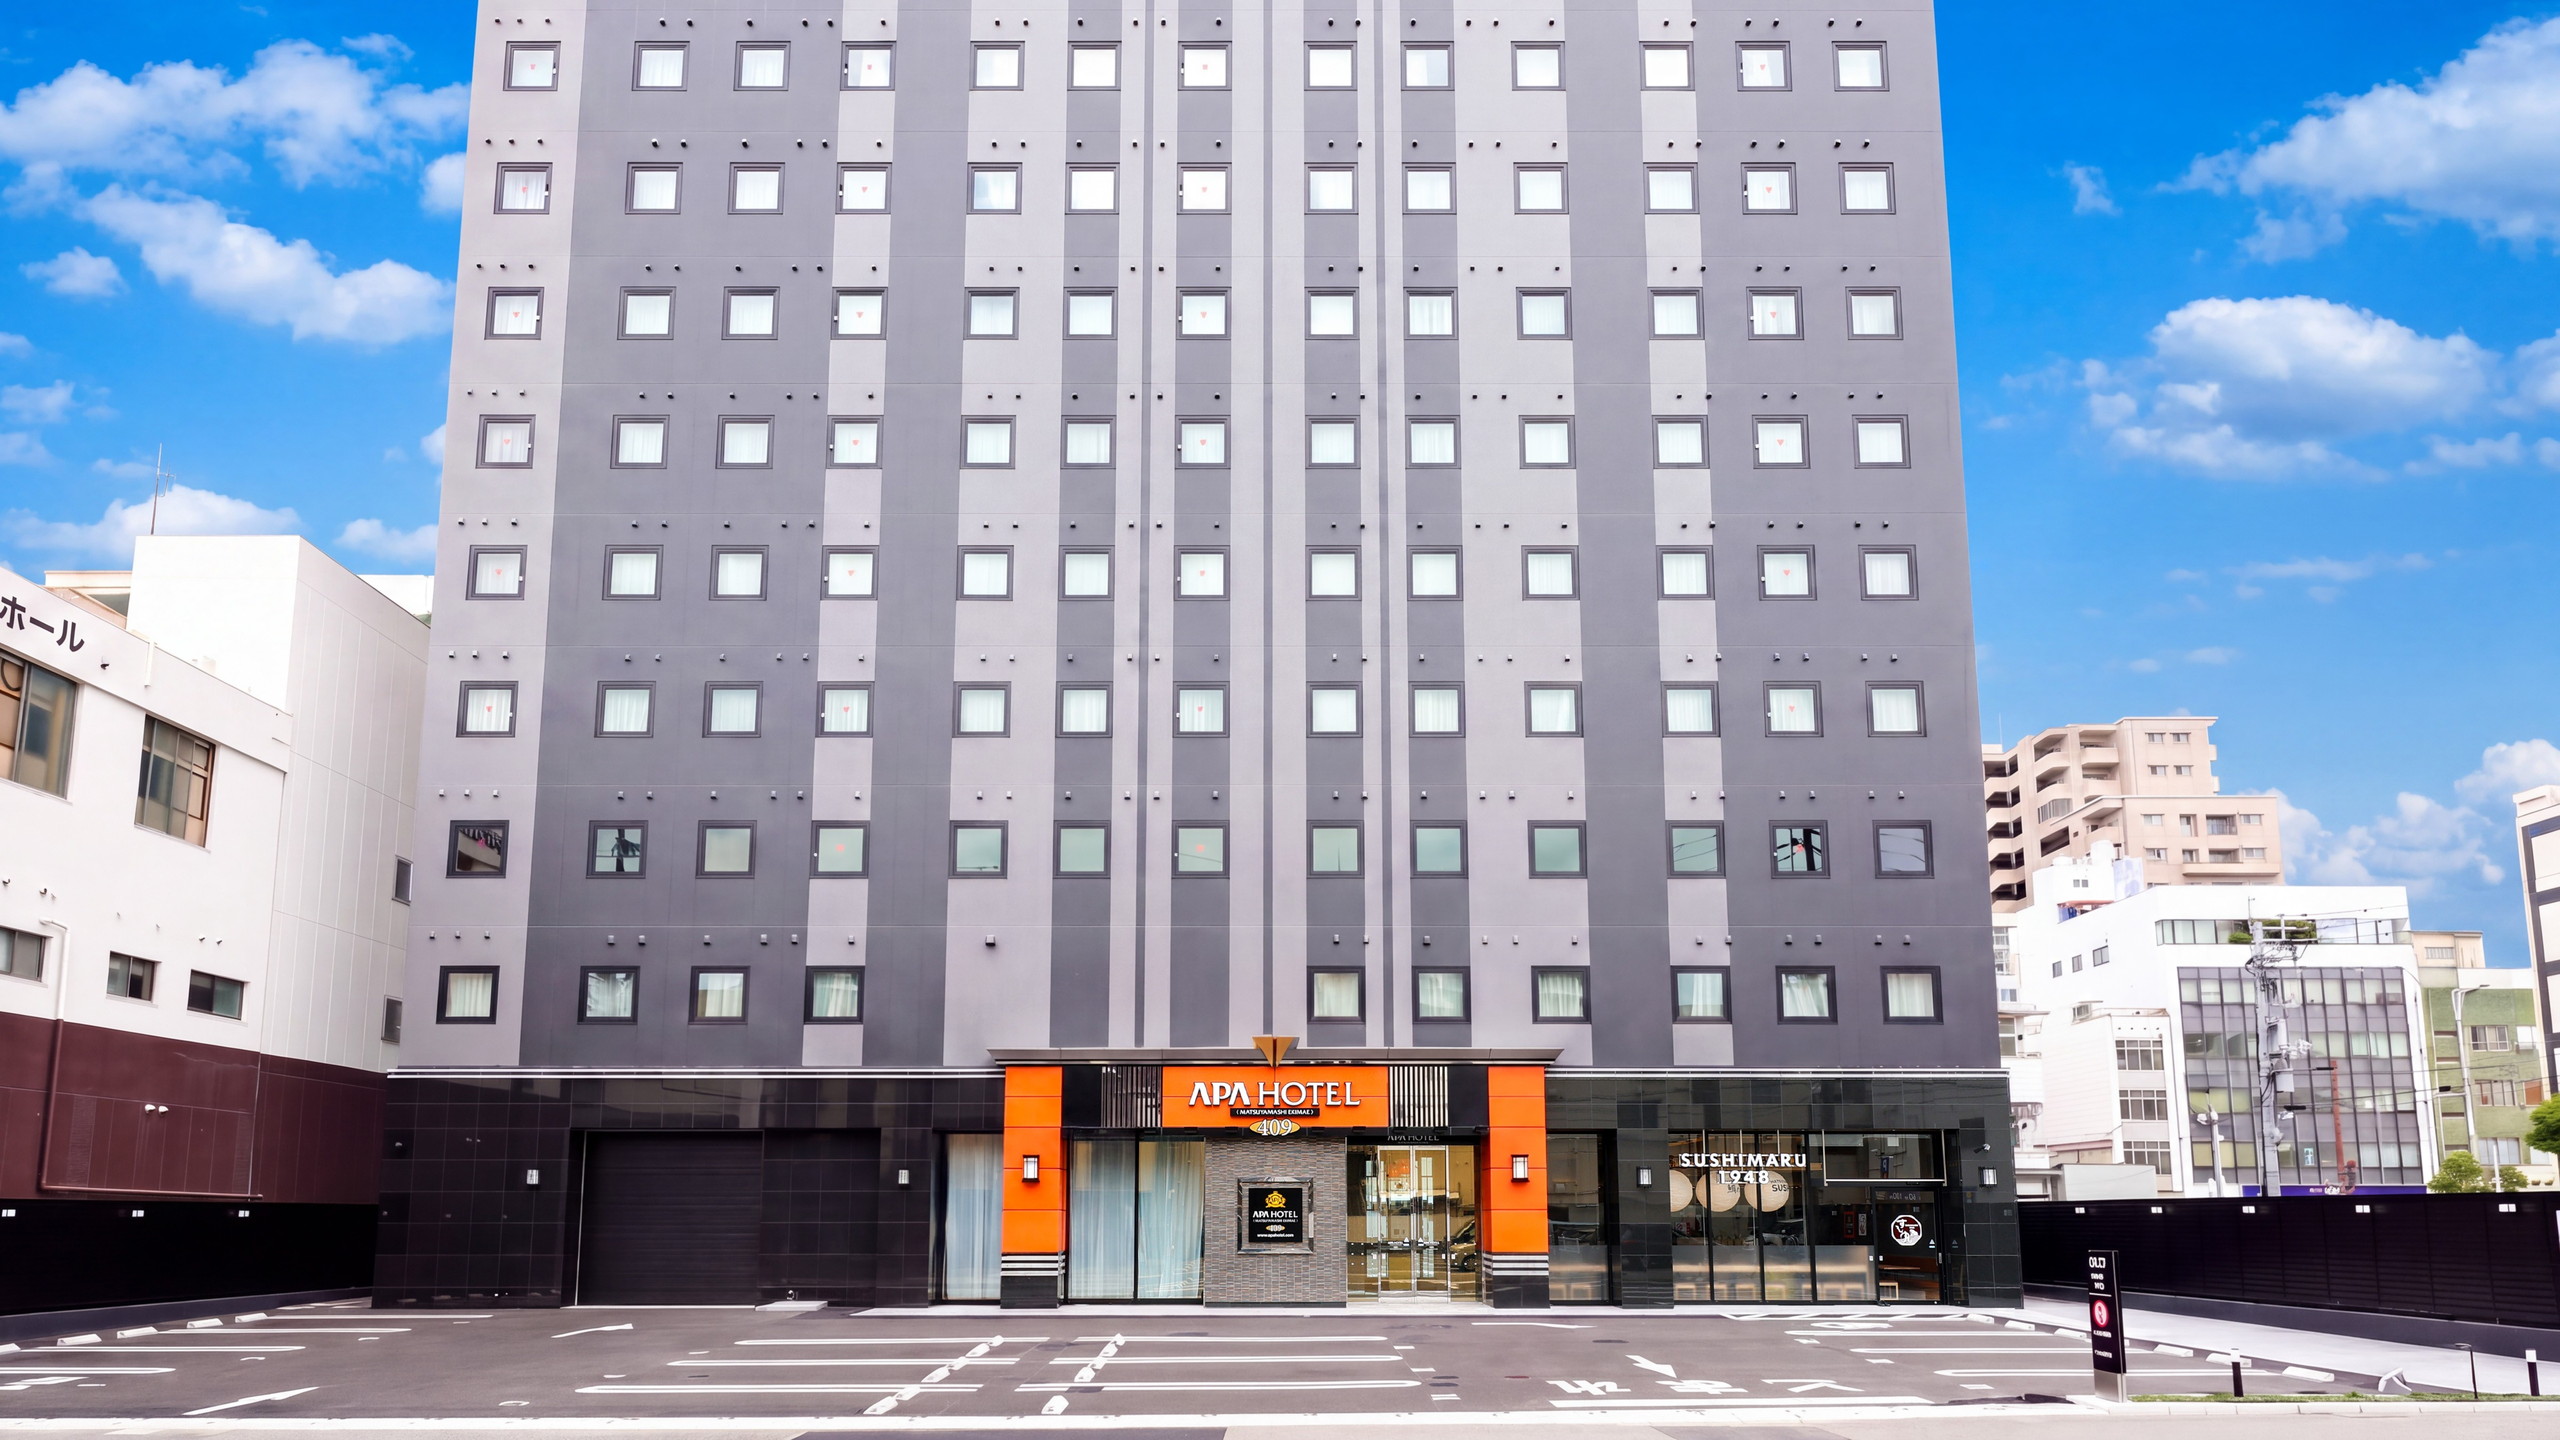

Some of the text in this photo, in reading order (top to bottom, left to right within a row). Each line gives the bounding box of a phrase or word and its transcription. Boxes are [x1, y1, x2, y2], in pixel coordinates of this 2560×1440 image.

[0, 596, 85, 652] ホール
[1189, 1081, 1361, 1106] APA HOTEL
[1257, 1118, 1293, 1136] 409
[1680, 1153, 1806, 1168] SUSHIMARU
[1718, 1170, 1769, 1184] 1948
[1252, 1210, 1298, 1218] APA HOTEL
